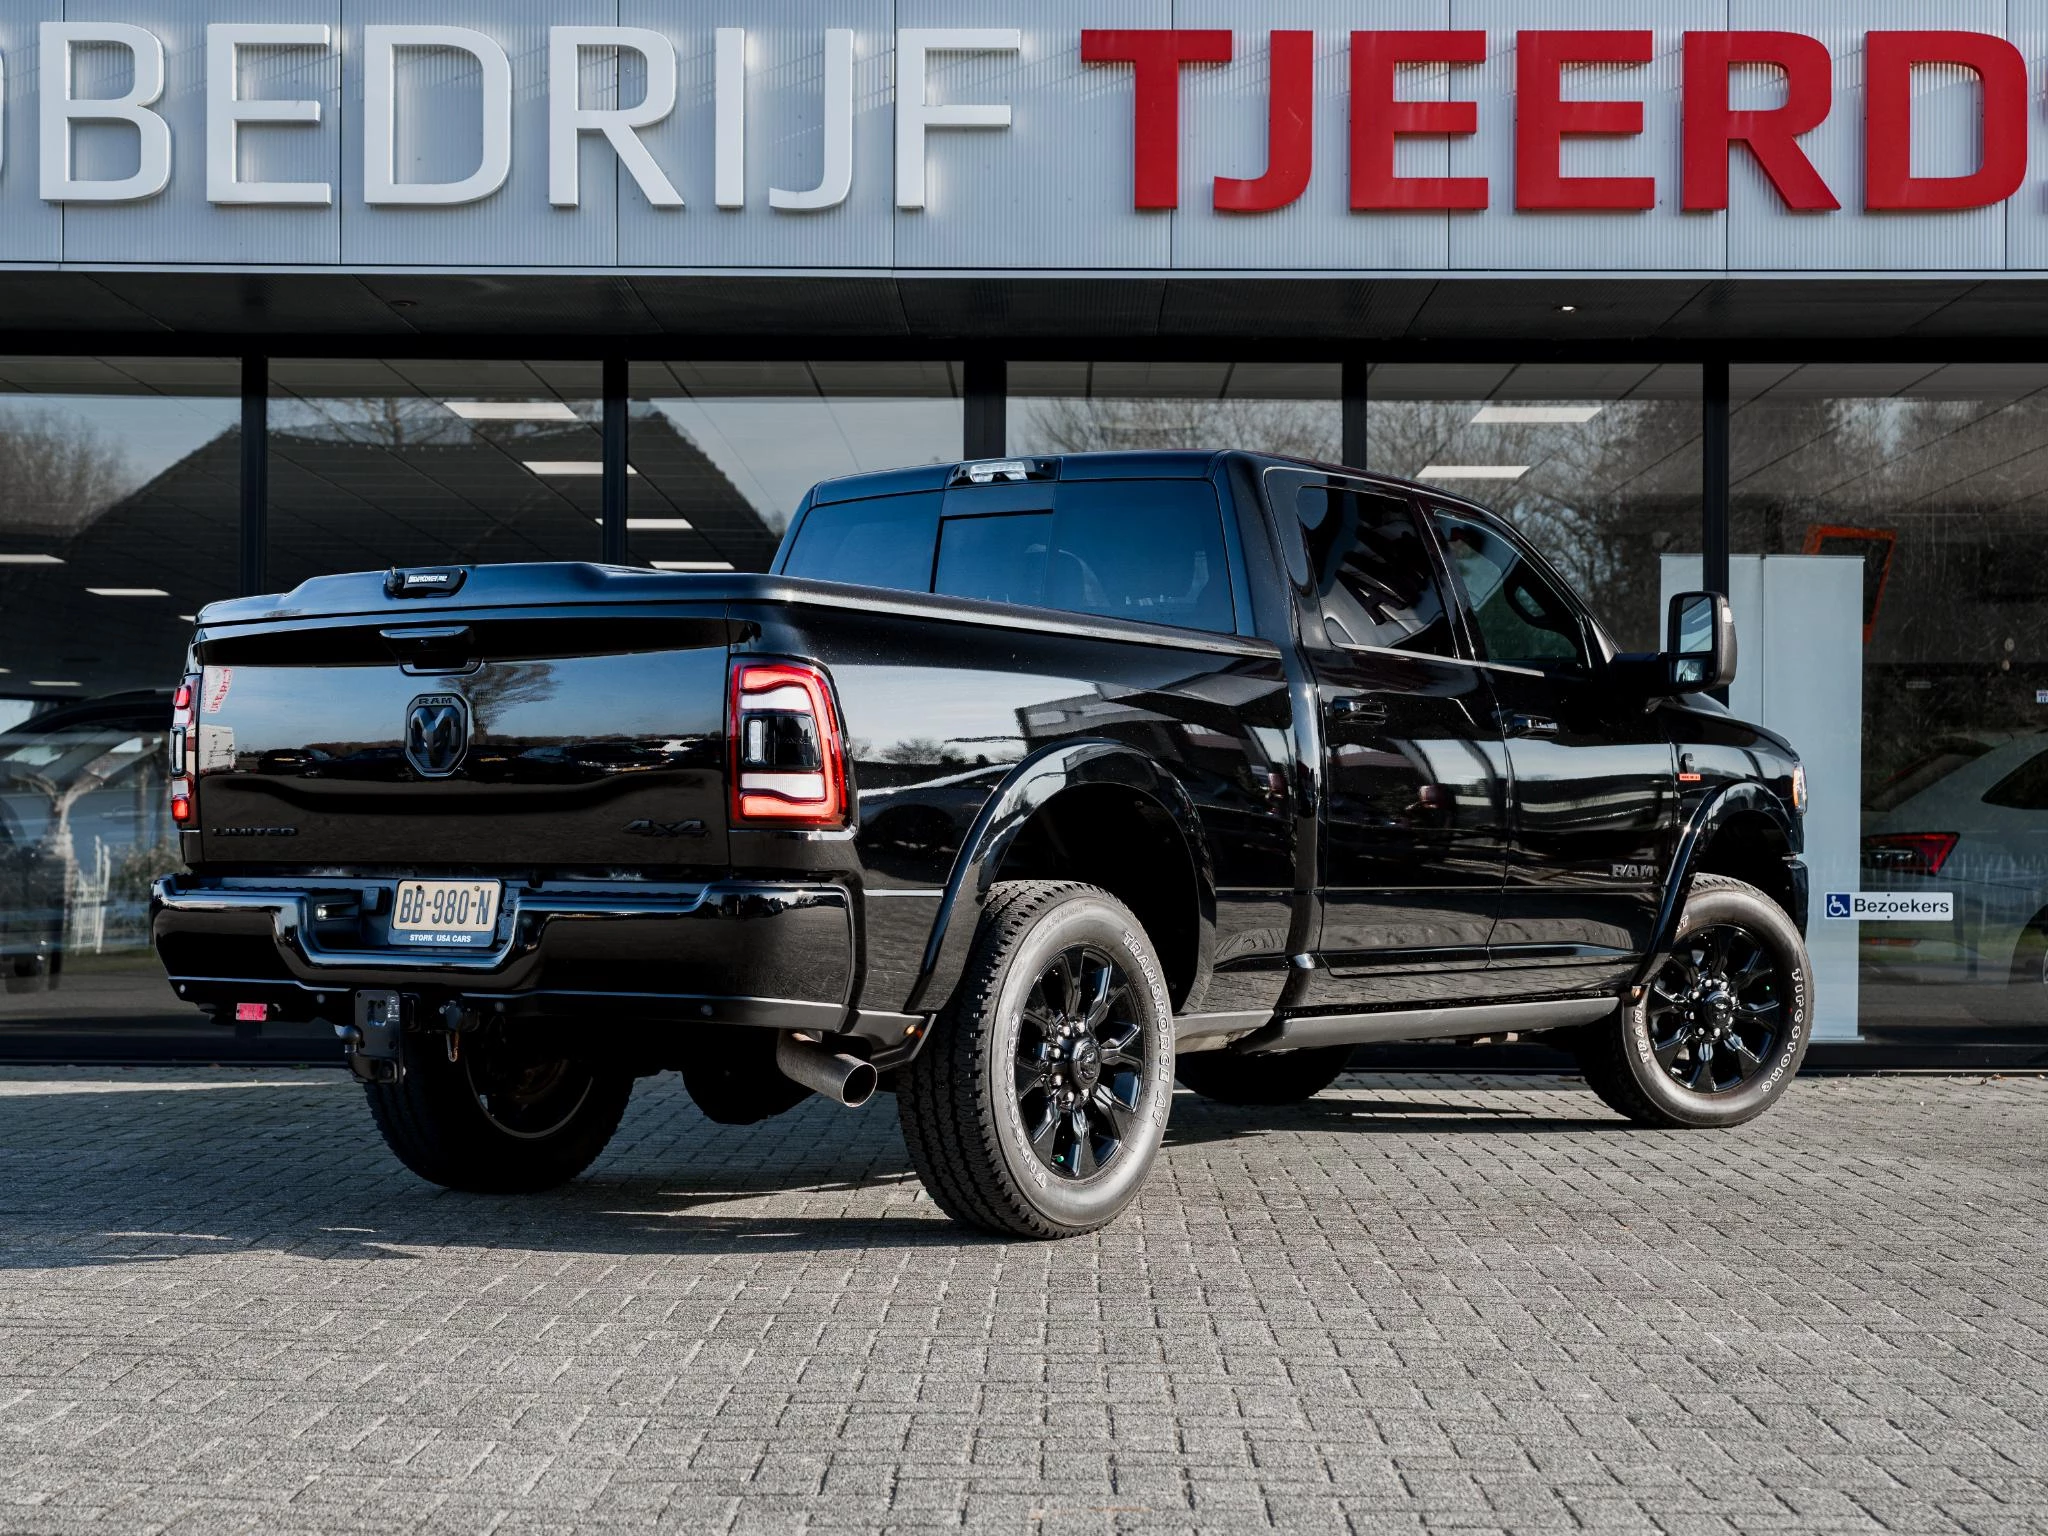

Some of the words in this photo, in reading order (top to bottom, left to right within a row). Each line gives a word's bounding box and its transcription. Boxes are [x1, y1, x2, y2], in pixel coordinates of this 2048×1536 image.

[0, 21, 1022, 211] BEDRIJF
[1080, 29, 2048, 213] TJEERD
[418, 697, 453, 705] RAM
[1611, 863, 1655, 878] RAM
[399, 888, 492, 925] BB-980-N
[1854, 898, 1950, 913] Bezoekers
[409, 934, 433, 942] STORK
[436, 934, 450, 943] USA
[451, 935, 472, 943] CARS
[1123, 930, 1172, 1084] TRANSFORCE
[1152, 1089, 1167, 1128] AT
